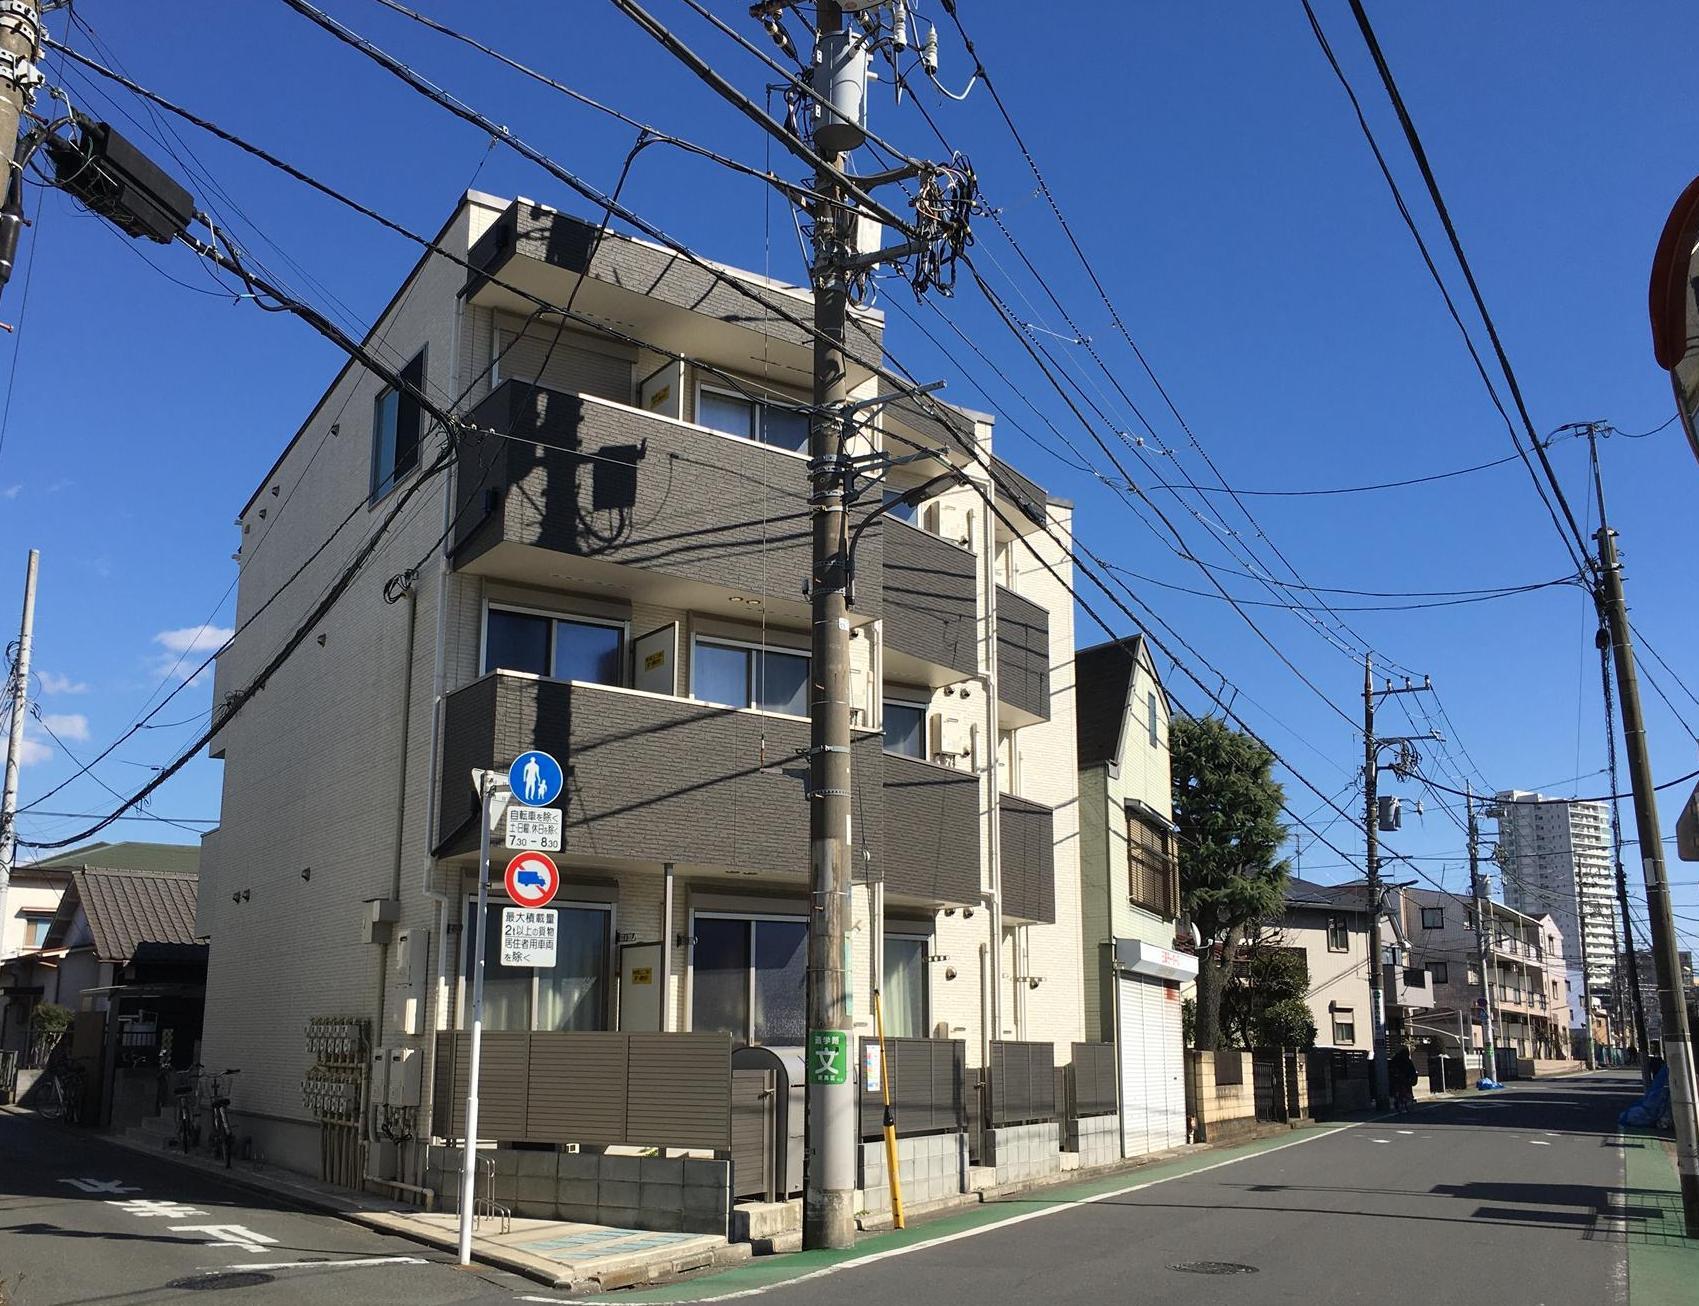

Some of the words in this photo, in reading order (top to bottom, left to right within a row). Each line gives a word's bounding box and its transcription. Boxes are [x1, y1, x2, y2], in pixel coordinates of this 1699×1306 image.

[510, 810, 559, 823] 自転車を除く
[505, 911, 554, 924] 最大積載量
[505, 937, 554, 950] 居住者用車両
[504, 951, 531, 962] を除く
[814, 1046, 840, 1074] 文
